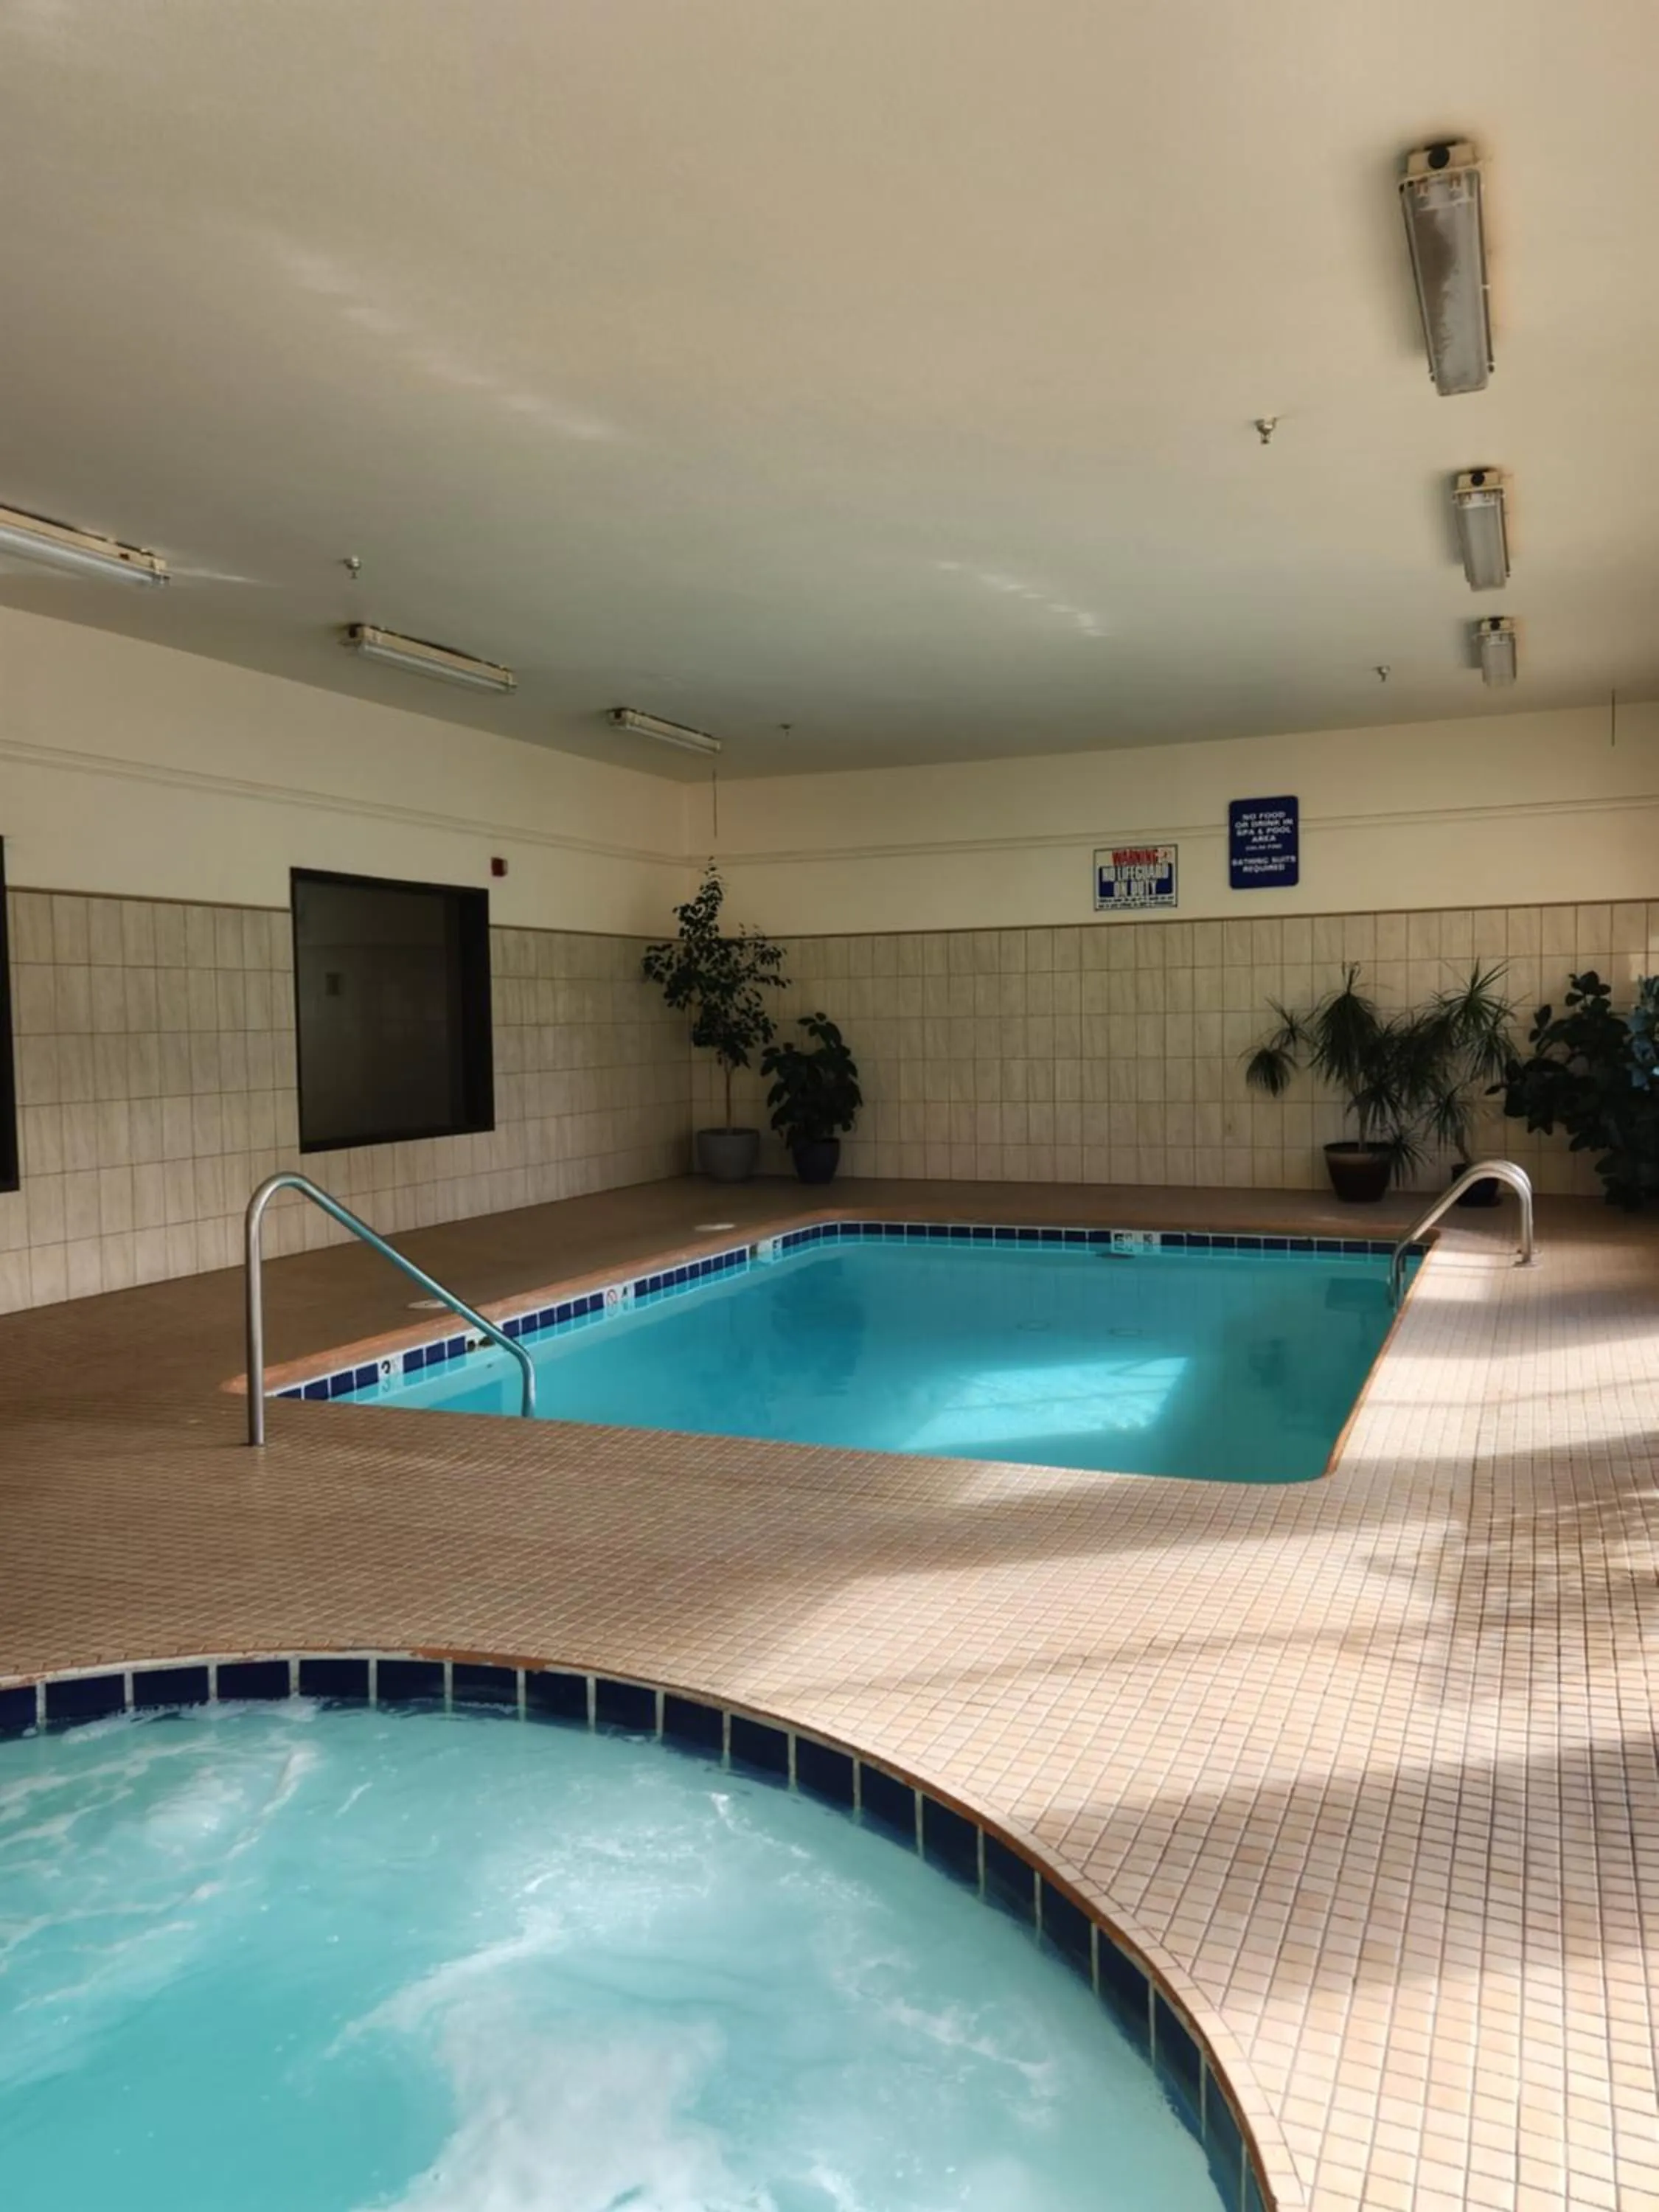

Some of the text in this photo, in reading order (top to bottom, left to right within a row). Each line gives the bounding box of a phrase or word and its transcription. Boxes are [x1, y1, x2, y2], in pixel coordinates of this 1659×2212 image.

[1259, 811, 1286, 819] FOOD
[1235, 821, 1249, 829] OR
[1251, 819, 1280, 827] DRINK
[1266, 826, 1292, 834] POOL
[1252, 835, 1276, 843] AREA
[1232, 858, 1268, 866] BATHING
[1117, 862, 1169, 881] LIFEGUARD
[1242, 863, 1285, 873] REQUIRED
[1130, 877, 1157, 897] DUTY
